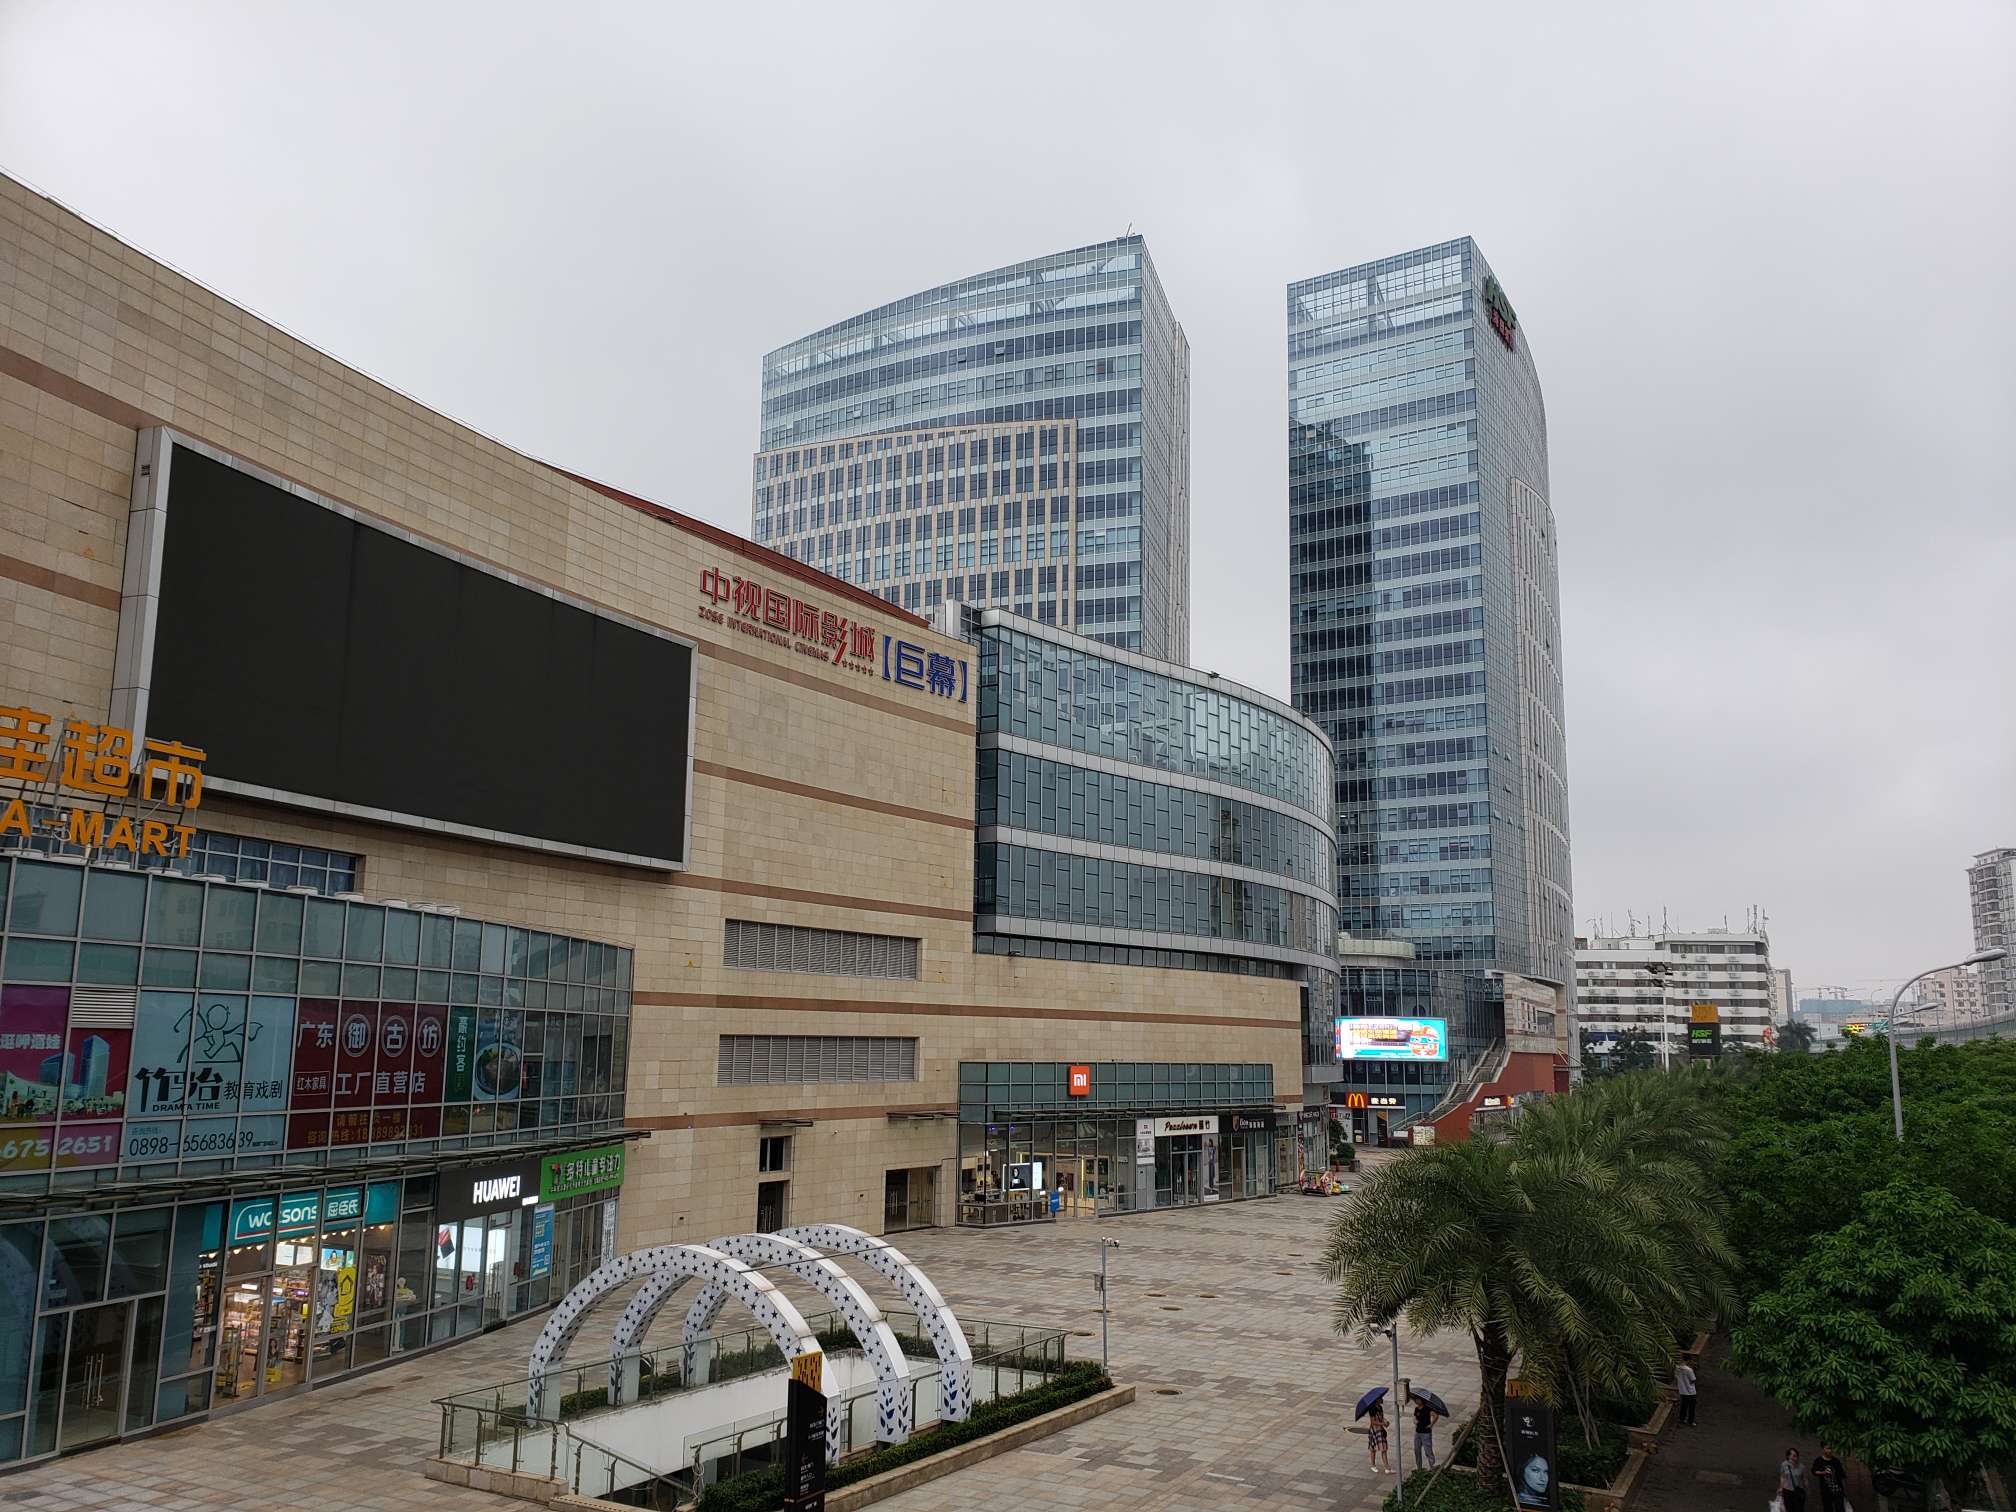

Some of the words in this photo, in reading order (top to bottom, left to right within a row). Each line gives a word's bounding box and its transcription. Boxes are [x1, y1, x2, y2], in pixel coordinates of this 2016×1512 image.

[700, 566, 876, 665] 中视国际影城
[726, 615, 791, 649] INTERNATIONAL
[223, 1079, 283, 1101] 教育戏剧
[297, 1076, 327, 1091] 红木家具
[336, 1070, 427, 1095] 工厂直营店
[152, 1103, 193, 1112] DRAMA
[196, 1102, 220, 1110] TIME
[472, 1175, 521, 1205] HUAWEI
[327, 1198, 359, 1218] 屈臣氏
